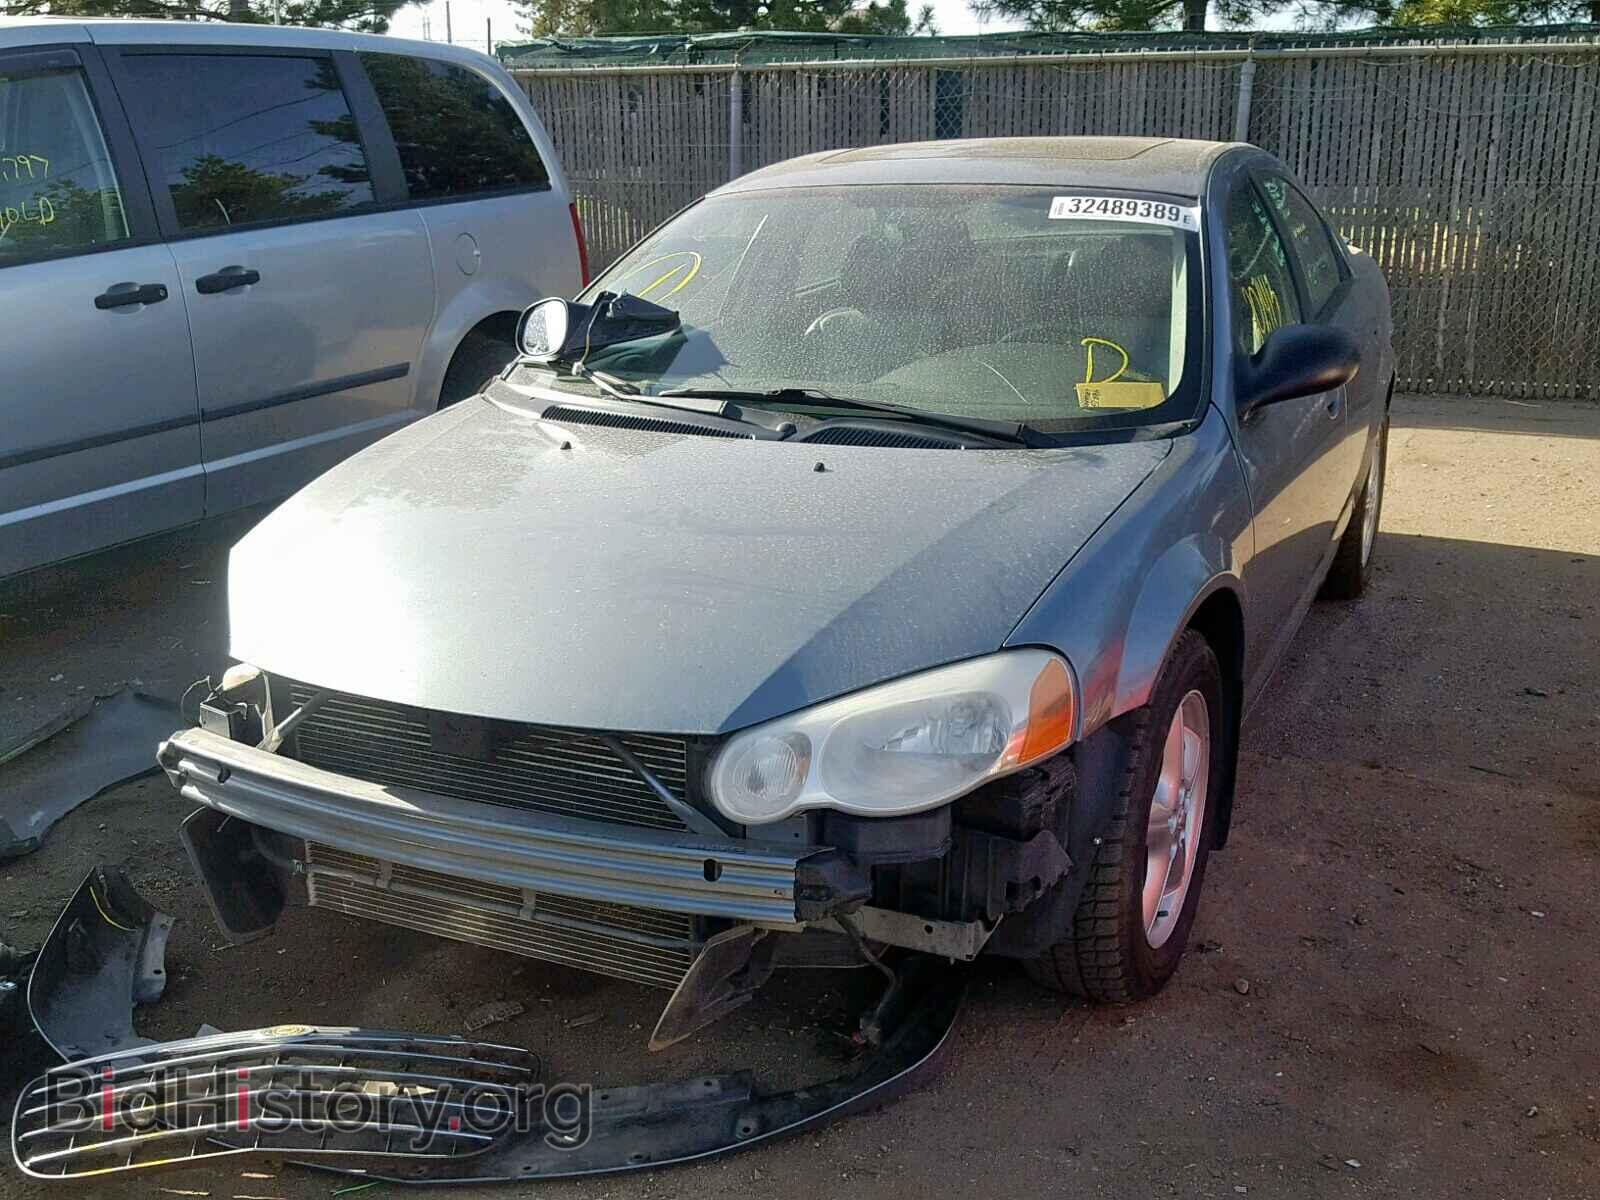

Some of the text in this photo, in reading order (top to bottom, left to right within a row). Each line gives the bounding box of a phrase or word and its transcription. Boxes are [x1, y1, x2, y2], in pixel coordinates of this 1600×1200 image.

[0, 154, 49, 180] 797
[1068, 198, 1181, 222] 32489389
[1080, 337, 1129, 384] D
